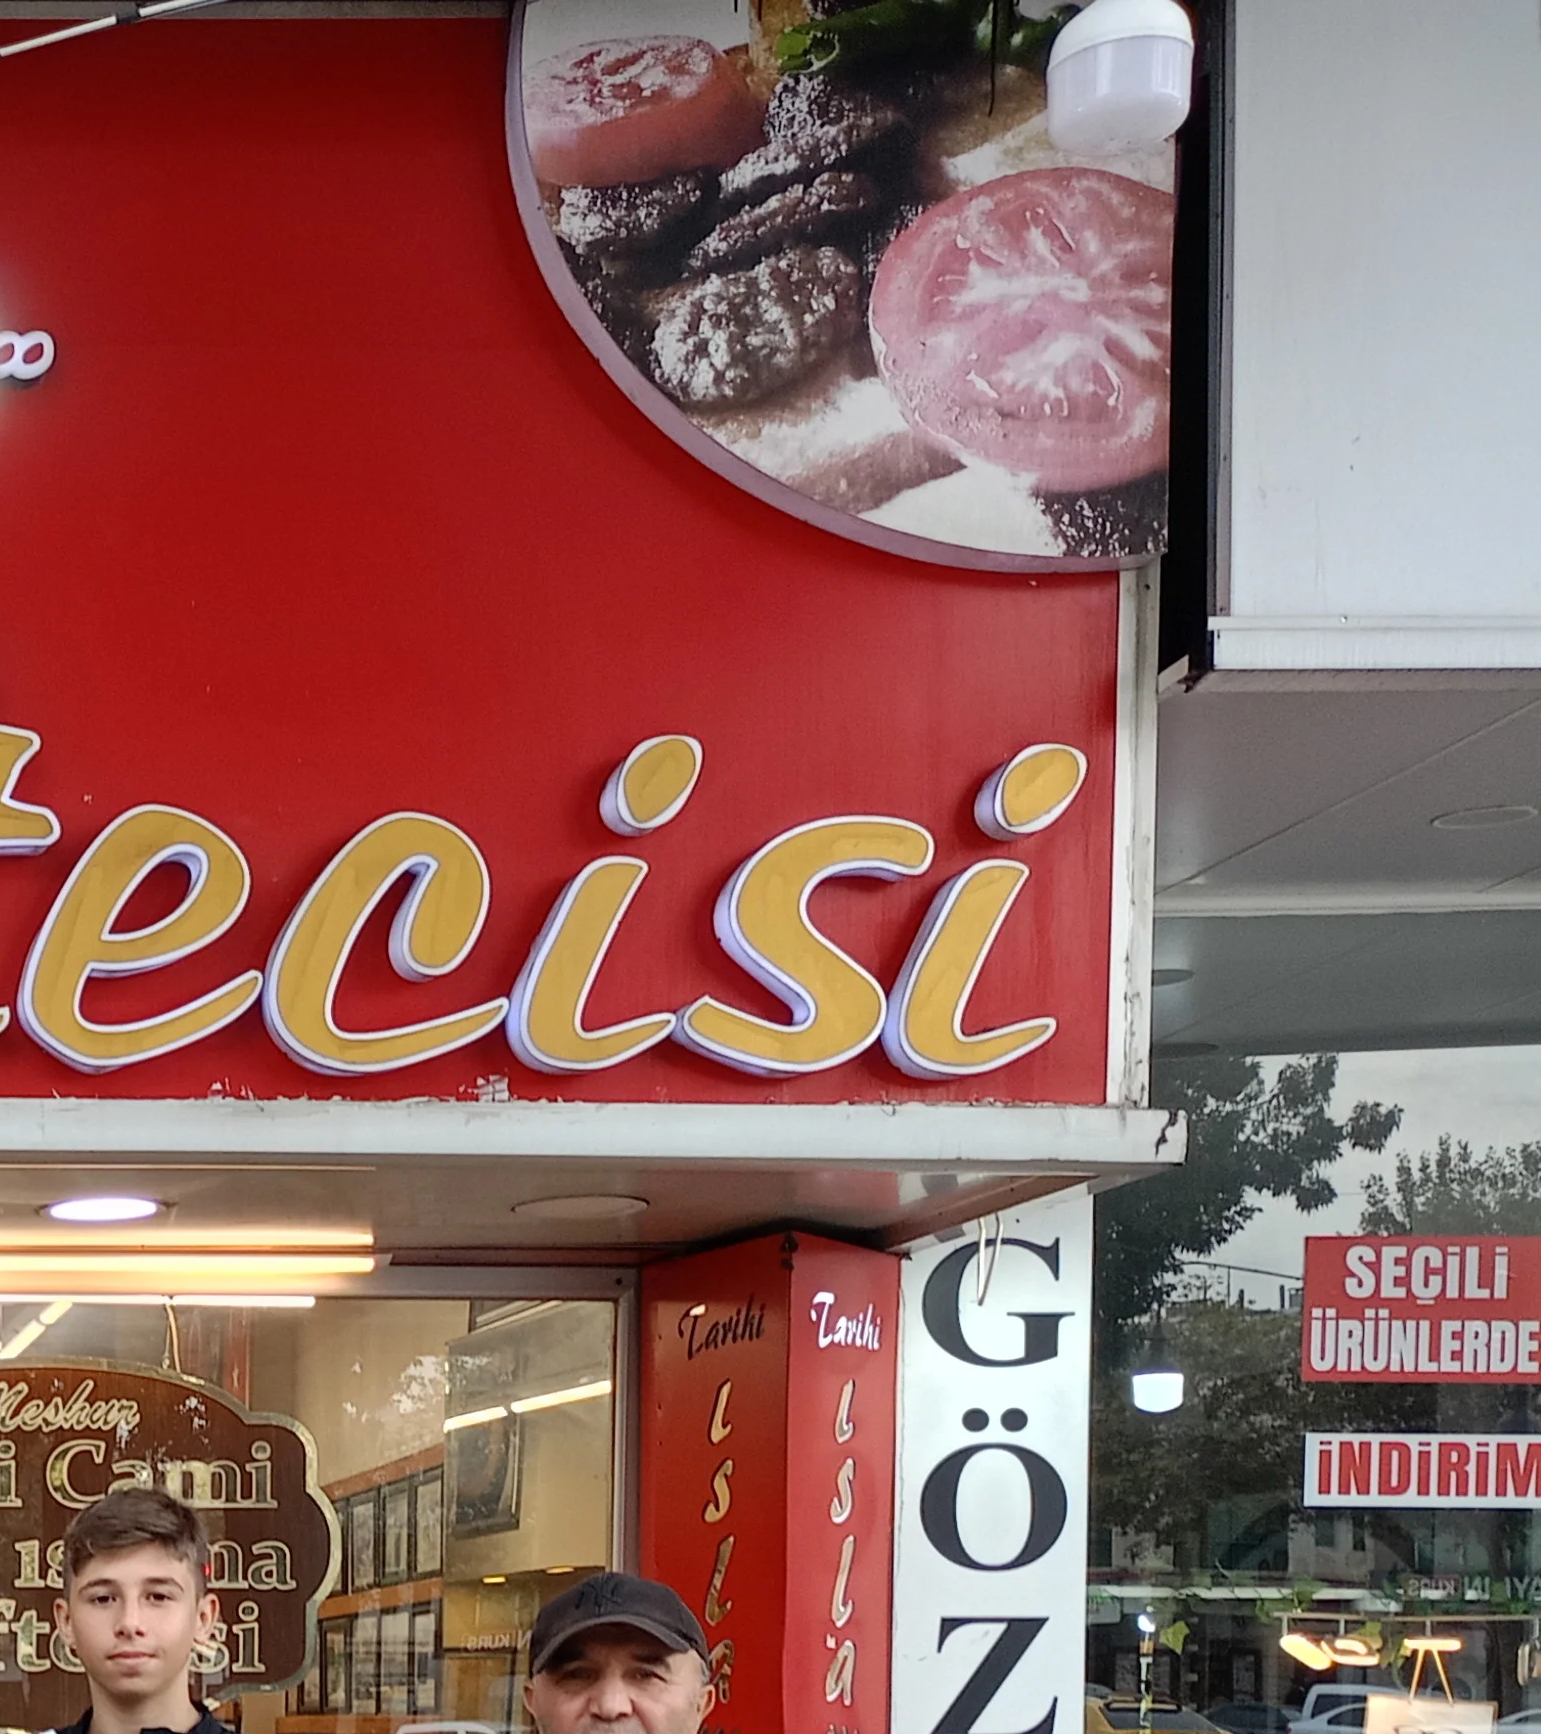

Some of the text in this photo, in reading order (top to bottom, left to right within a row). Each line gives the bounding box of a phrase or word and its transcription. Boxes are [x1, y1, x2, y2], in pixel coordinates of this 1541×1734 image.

[1345, 1244, 1509, 1304] SEÇİLİ
[811, 1291, 881, 1351] Tarihi
[1310, 1310, 1539, 1373] ÜRÜNLERDE
[46, 1438, 280, 1510] Cami
[1317, 1440, 1541, 1498] İNDİRİM
